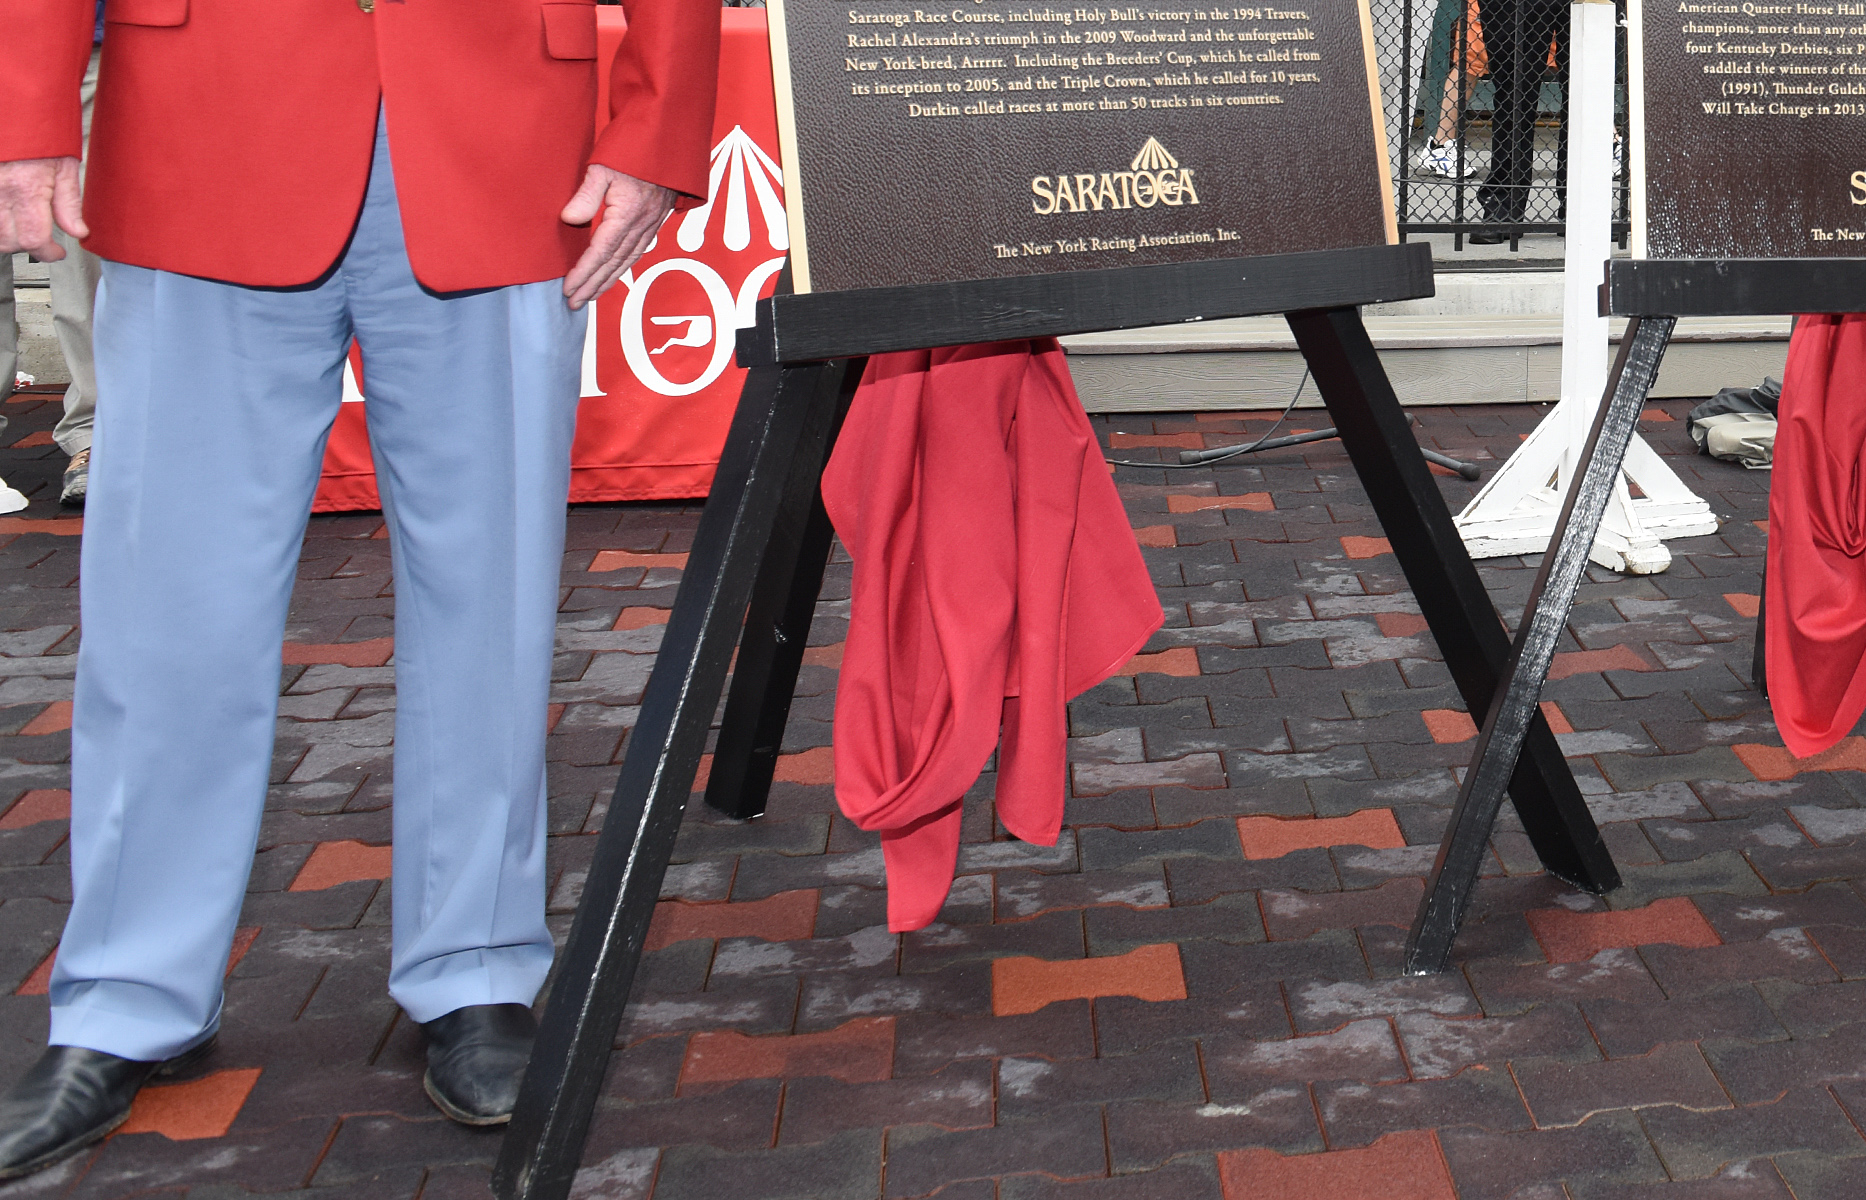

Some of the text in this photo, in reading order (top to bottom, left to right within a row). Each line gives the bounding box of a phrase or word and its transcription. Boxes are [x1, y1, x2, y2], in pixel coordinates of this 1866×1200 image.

[849, 8, 1310, 28] Saratoga Race Course, including Holy Bull's victory in the 1994 Travers,
[1678, 2, 1738, 13] American
[1741, 2, 1792, 17] Quarter
[1796, 3, 1834, 15] Horse
[1838, 3, 1865, 16] Hall
[1682, 21, 1754, 37] champions,
[1758, 26, 1790, 34] more
[1793, 22, 1821, 35] than
[1824, 27, 1846, 38] any
[1031, 169, 1200, 215] SARATOGA
[993, 228, 1241, 258] The New York Racing Association, Inc.
[1810, 228, 1834, 241] The
[1835, 228, 1866, 241] New
